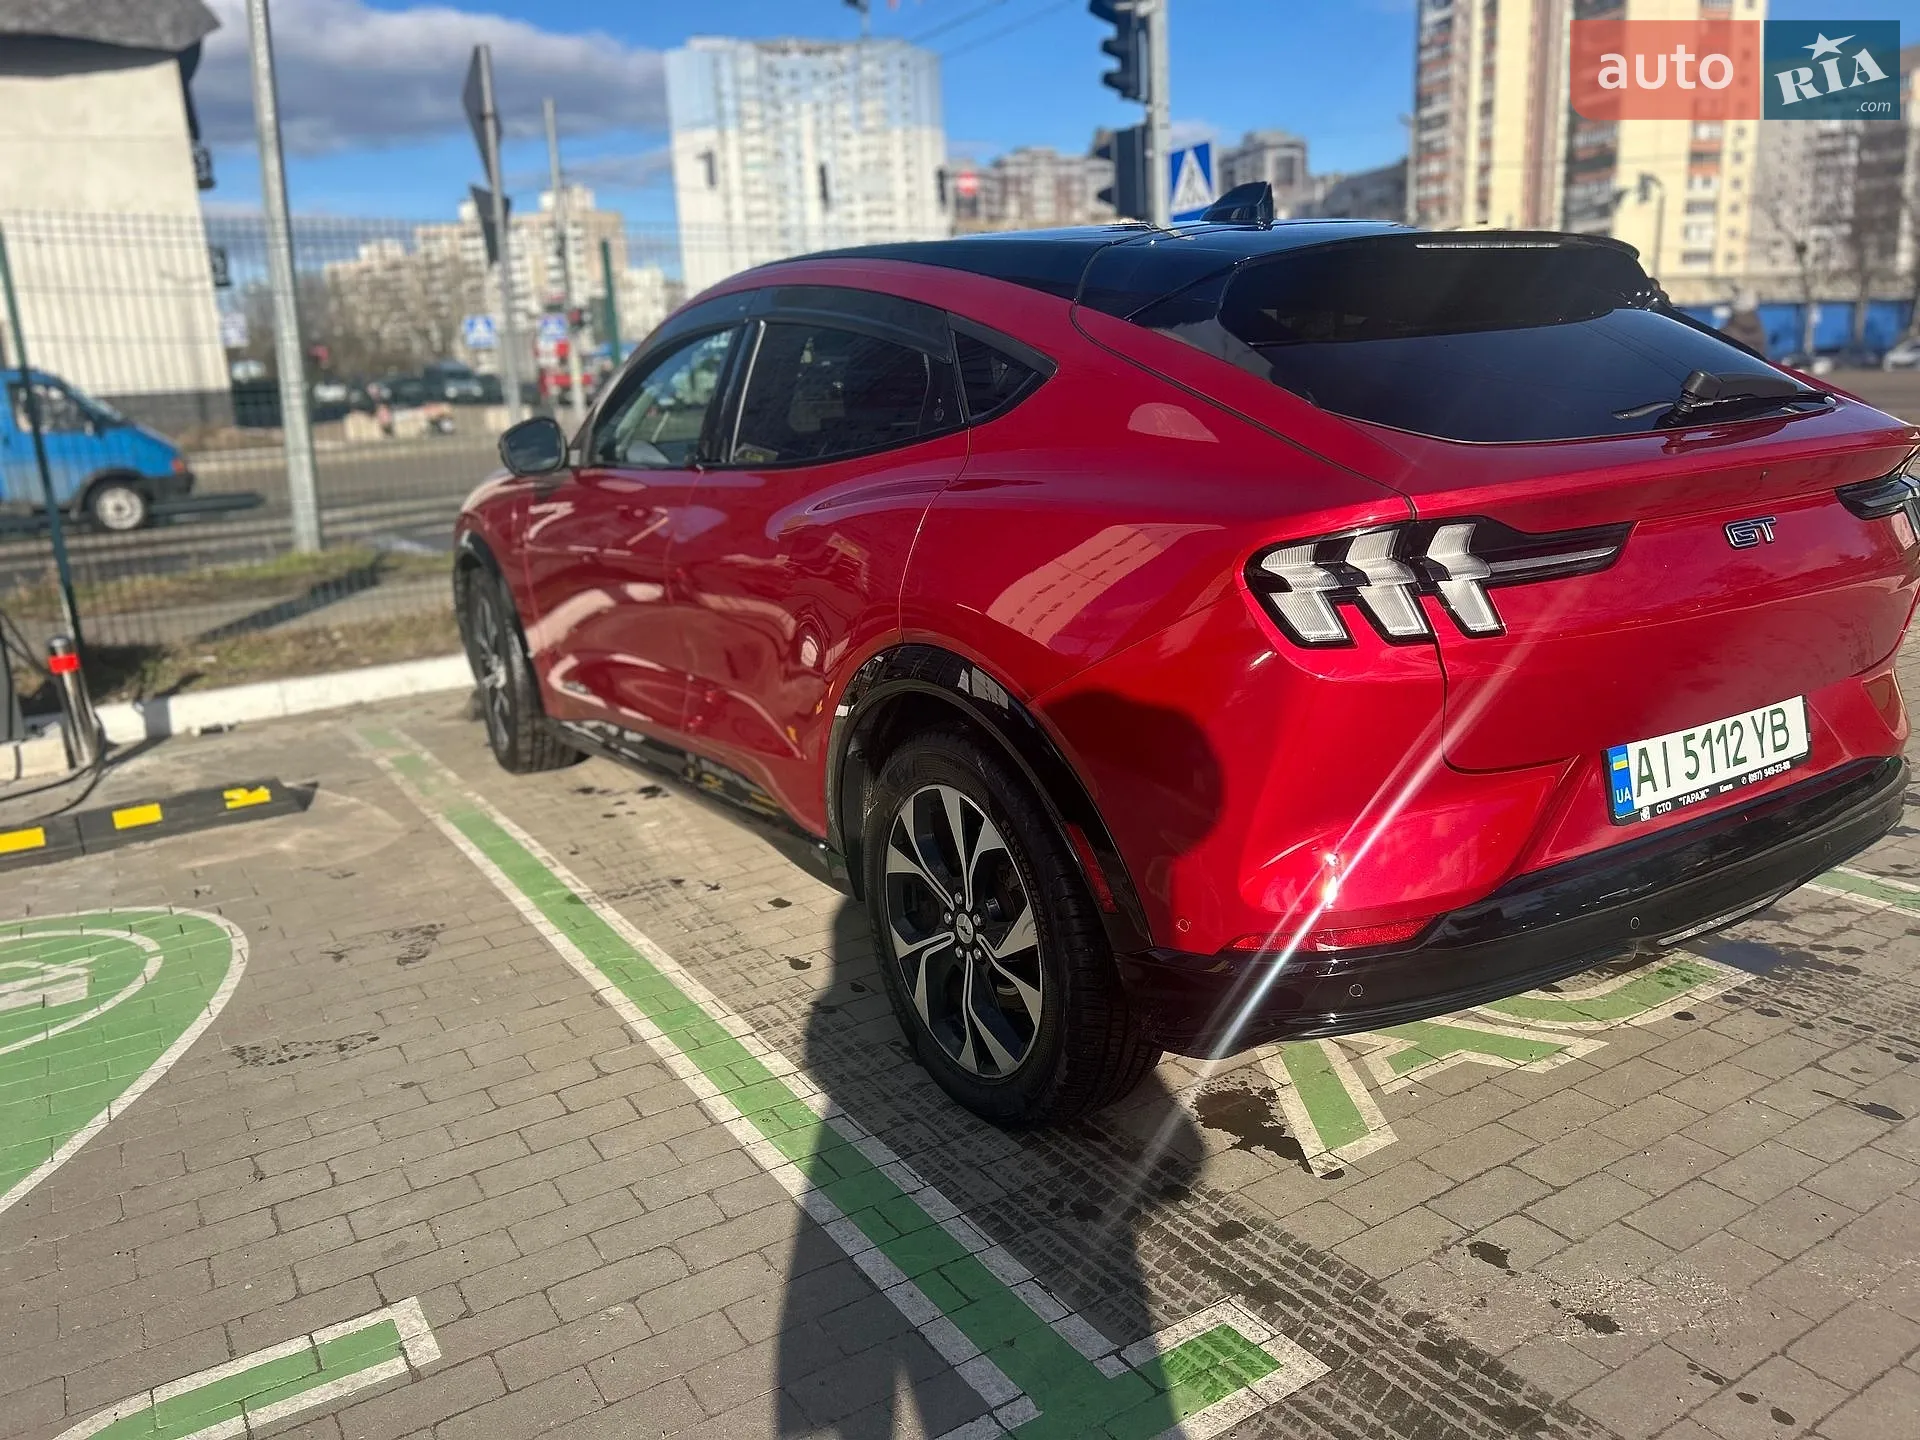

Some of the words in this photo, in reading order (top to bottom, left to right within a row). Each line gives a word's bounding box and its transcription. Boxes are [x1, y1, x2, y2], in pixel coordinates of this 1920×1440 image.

[1725, 516, 1776, 548] GT
[1637, 741, 1671, 798] AI
[1683, 720, 1747, 780] 5112
[1750, 707, 1790, 759] YB
[1616, 787, 1632, 803] UA
[1656, 801, 1671, 814] СТО
